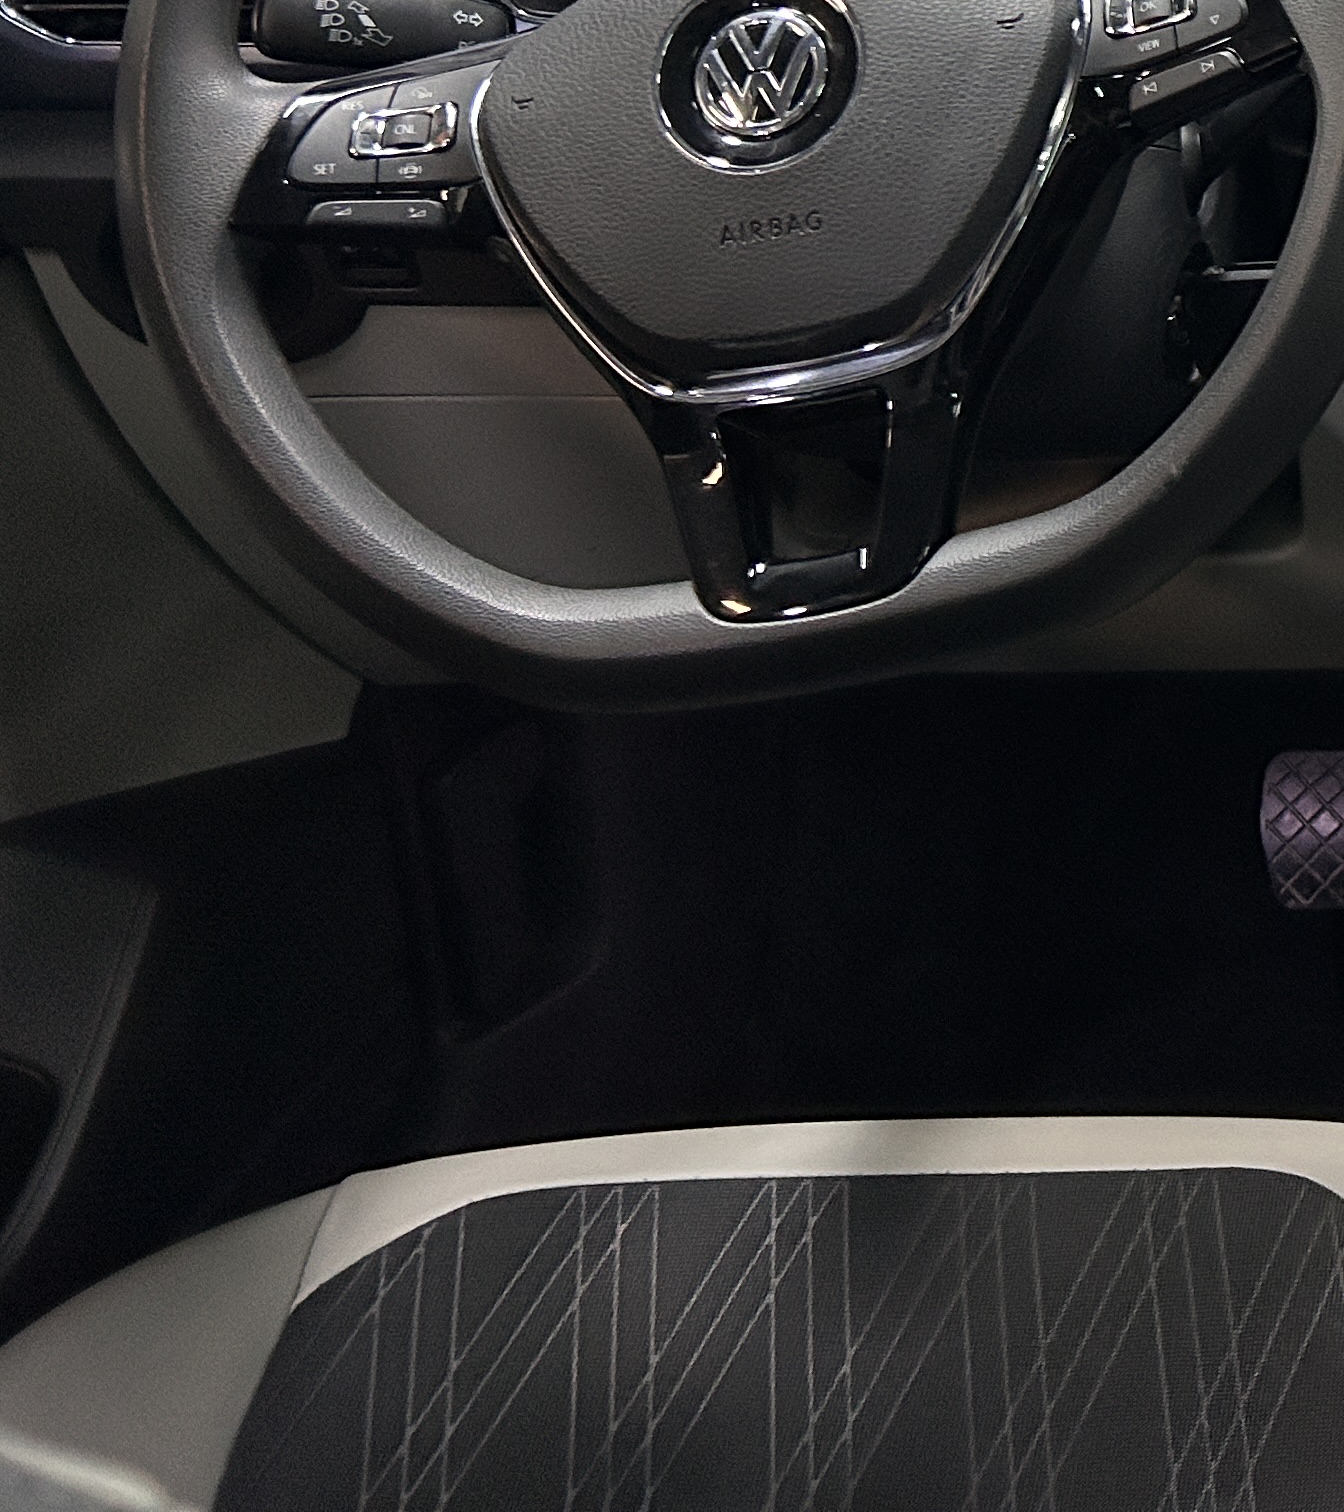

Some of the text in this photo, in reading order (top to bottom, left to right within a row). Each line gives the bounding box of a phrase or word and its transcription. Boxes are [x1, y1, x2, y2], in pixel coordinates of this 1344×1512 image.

[1138, 39, 1161, 53] VIEW
[394, 123, 417, 136] CNL
[313, 162, 337, 176] SET
[719, 209, 825, 250] AIRBAG
